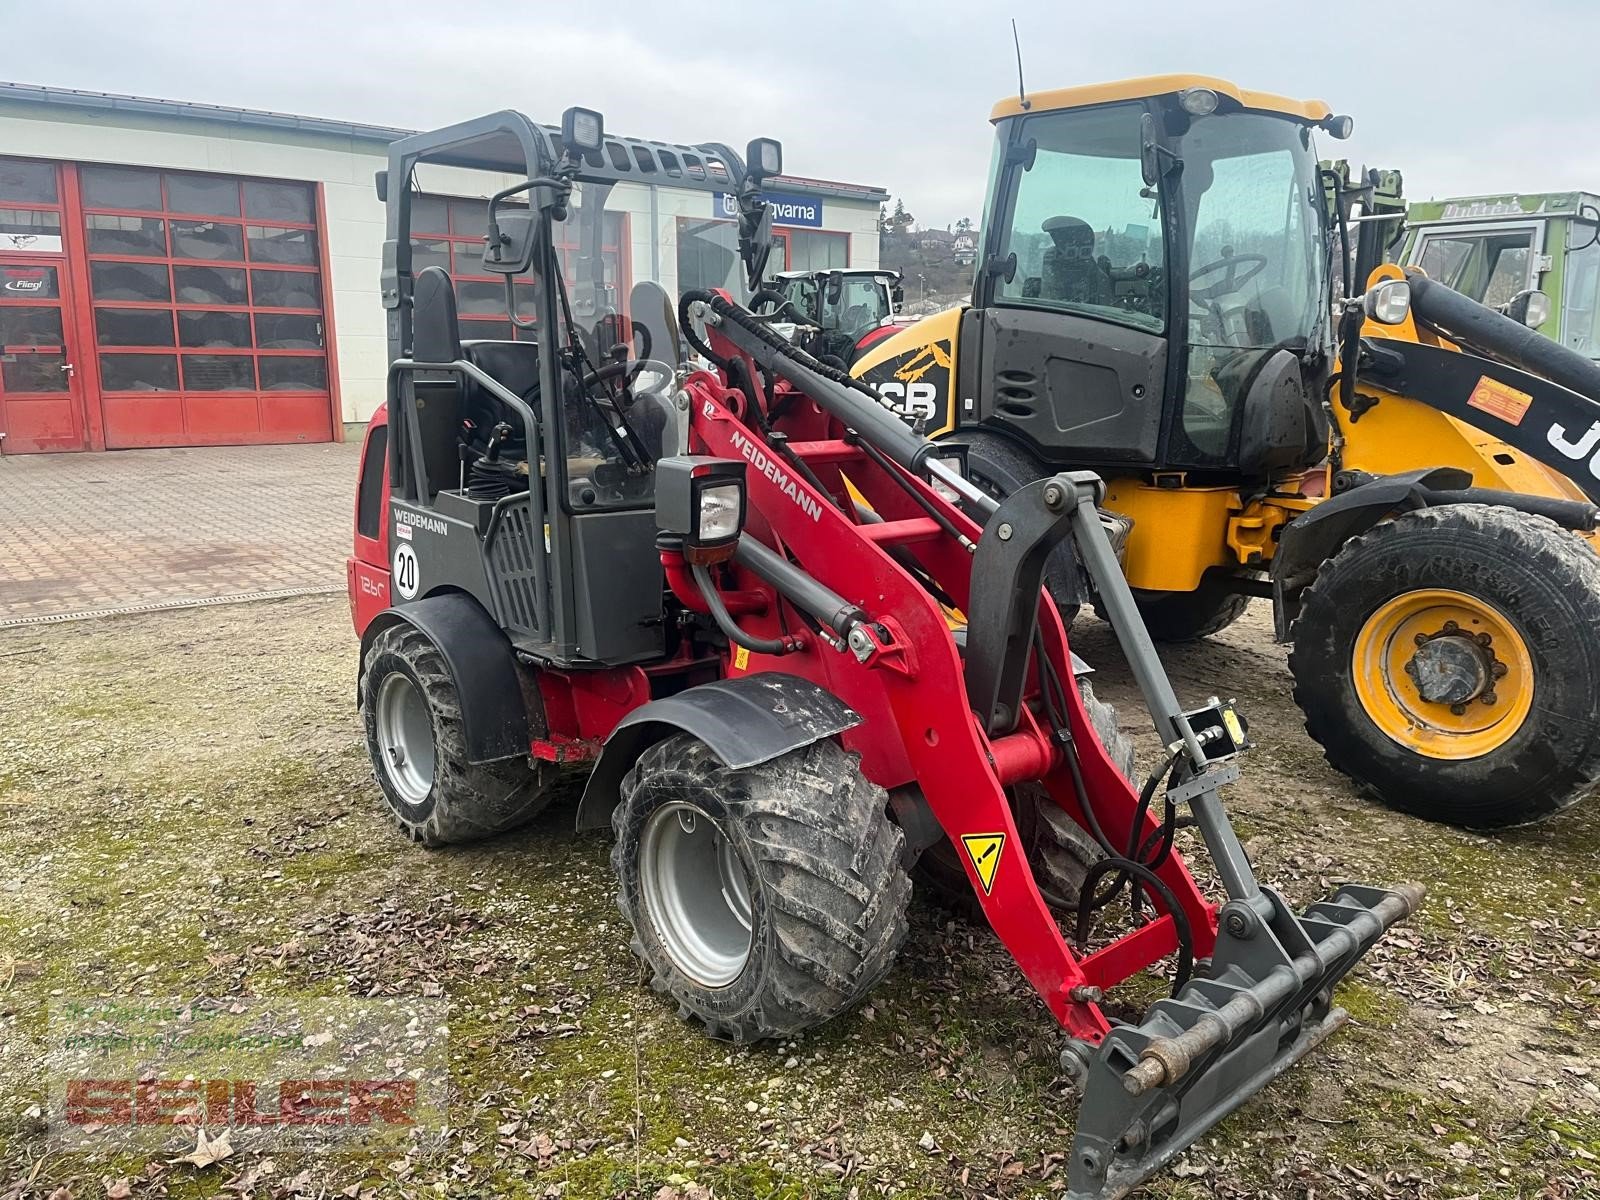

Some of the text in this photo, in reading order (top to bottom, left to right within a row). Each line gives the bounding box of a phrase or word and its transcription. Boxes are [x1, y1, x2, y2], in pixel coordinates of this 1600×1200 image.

[869, 382, 937, 420] CB
[393, 508, 448, 536] WEIDEMANN
[398, 552, 415, 591] 20
